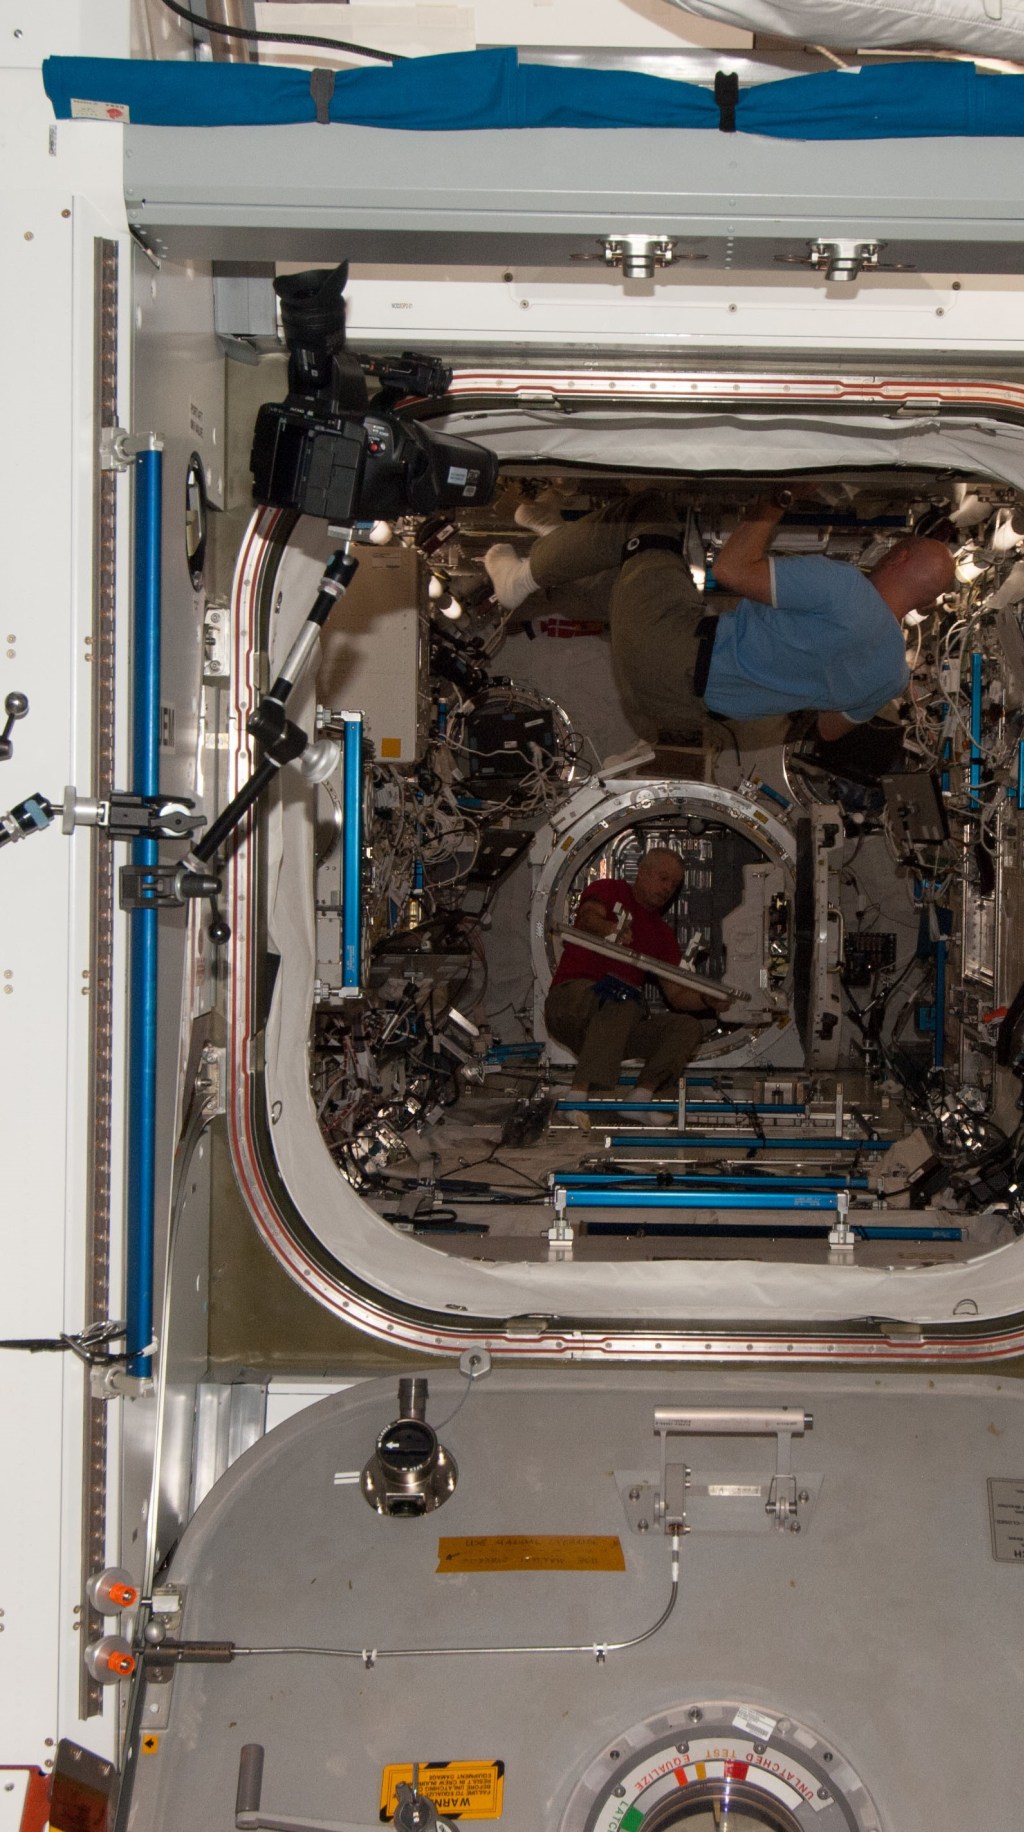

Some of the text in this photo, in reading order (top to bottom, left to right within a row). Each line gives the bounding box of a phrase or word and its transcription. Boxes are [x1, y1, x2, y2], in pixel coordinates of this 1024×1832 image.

[634, 1754, 690, 1792] EQUALIZE
[705, 1749, 736, 1759] TEST
[746, 1752, 814, 1799] UNLATCHED
